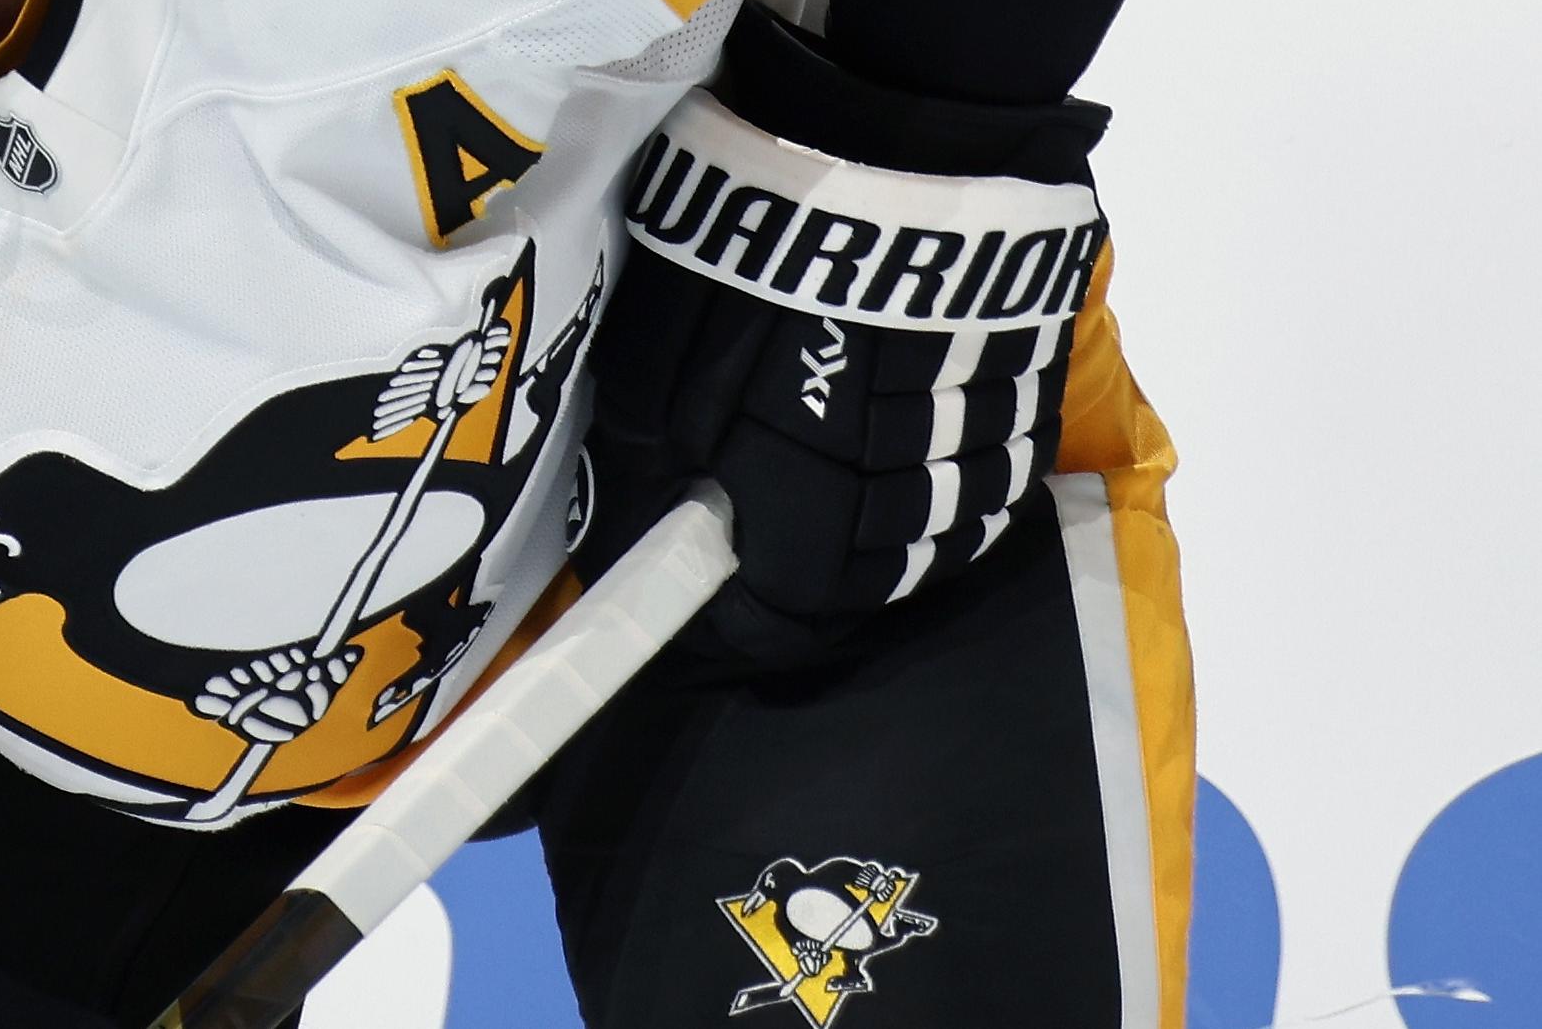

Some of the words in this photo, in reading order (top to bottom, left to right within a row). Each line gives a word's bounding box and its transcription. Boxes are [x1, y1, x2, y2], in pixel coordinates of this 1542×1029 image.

[8, 132, 32, 181] NHL
[392, 68, 549, 250] A
[624, 132, 1106, 322] WARRIOR
